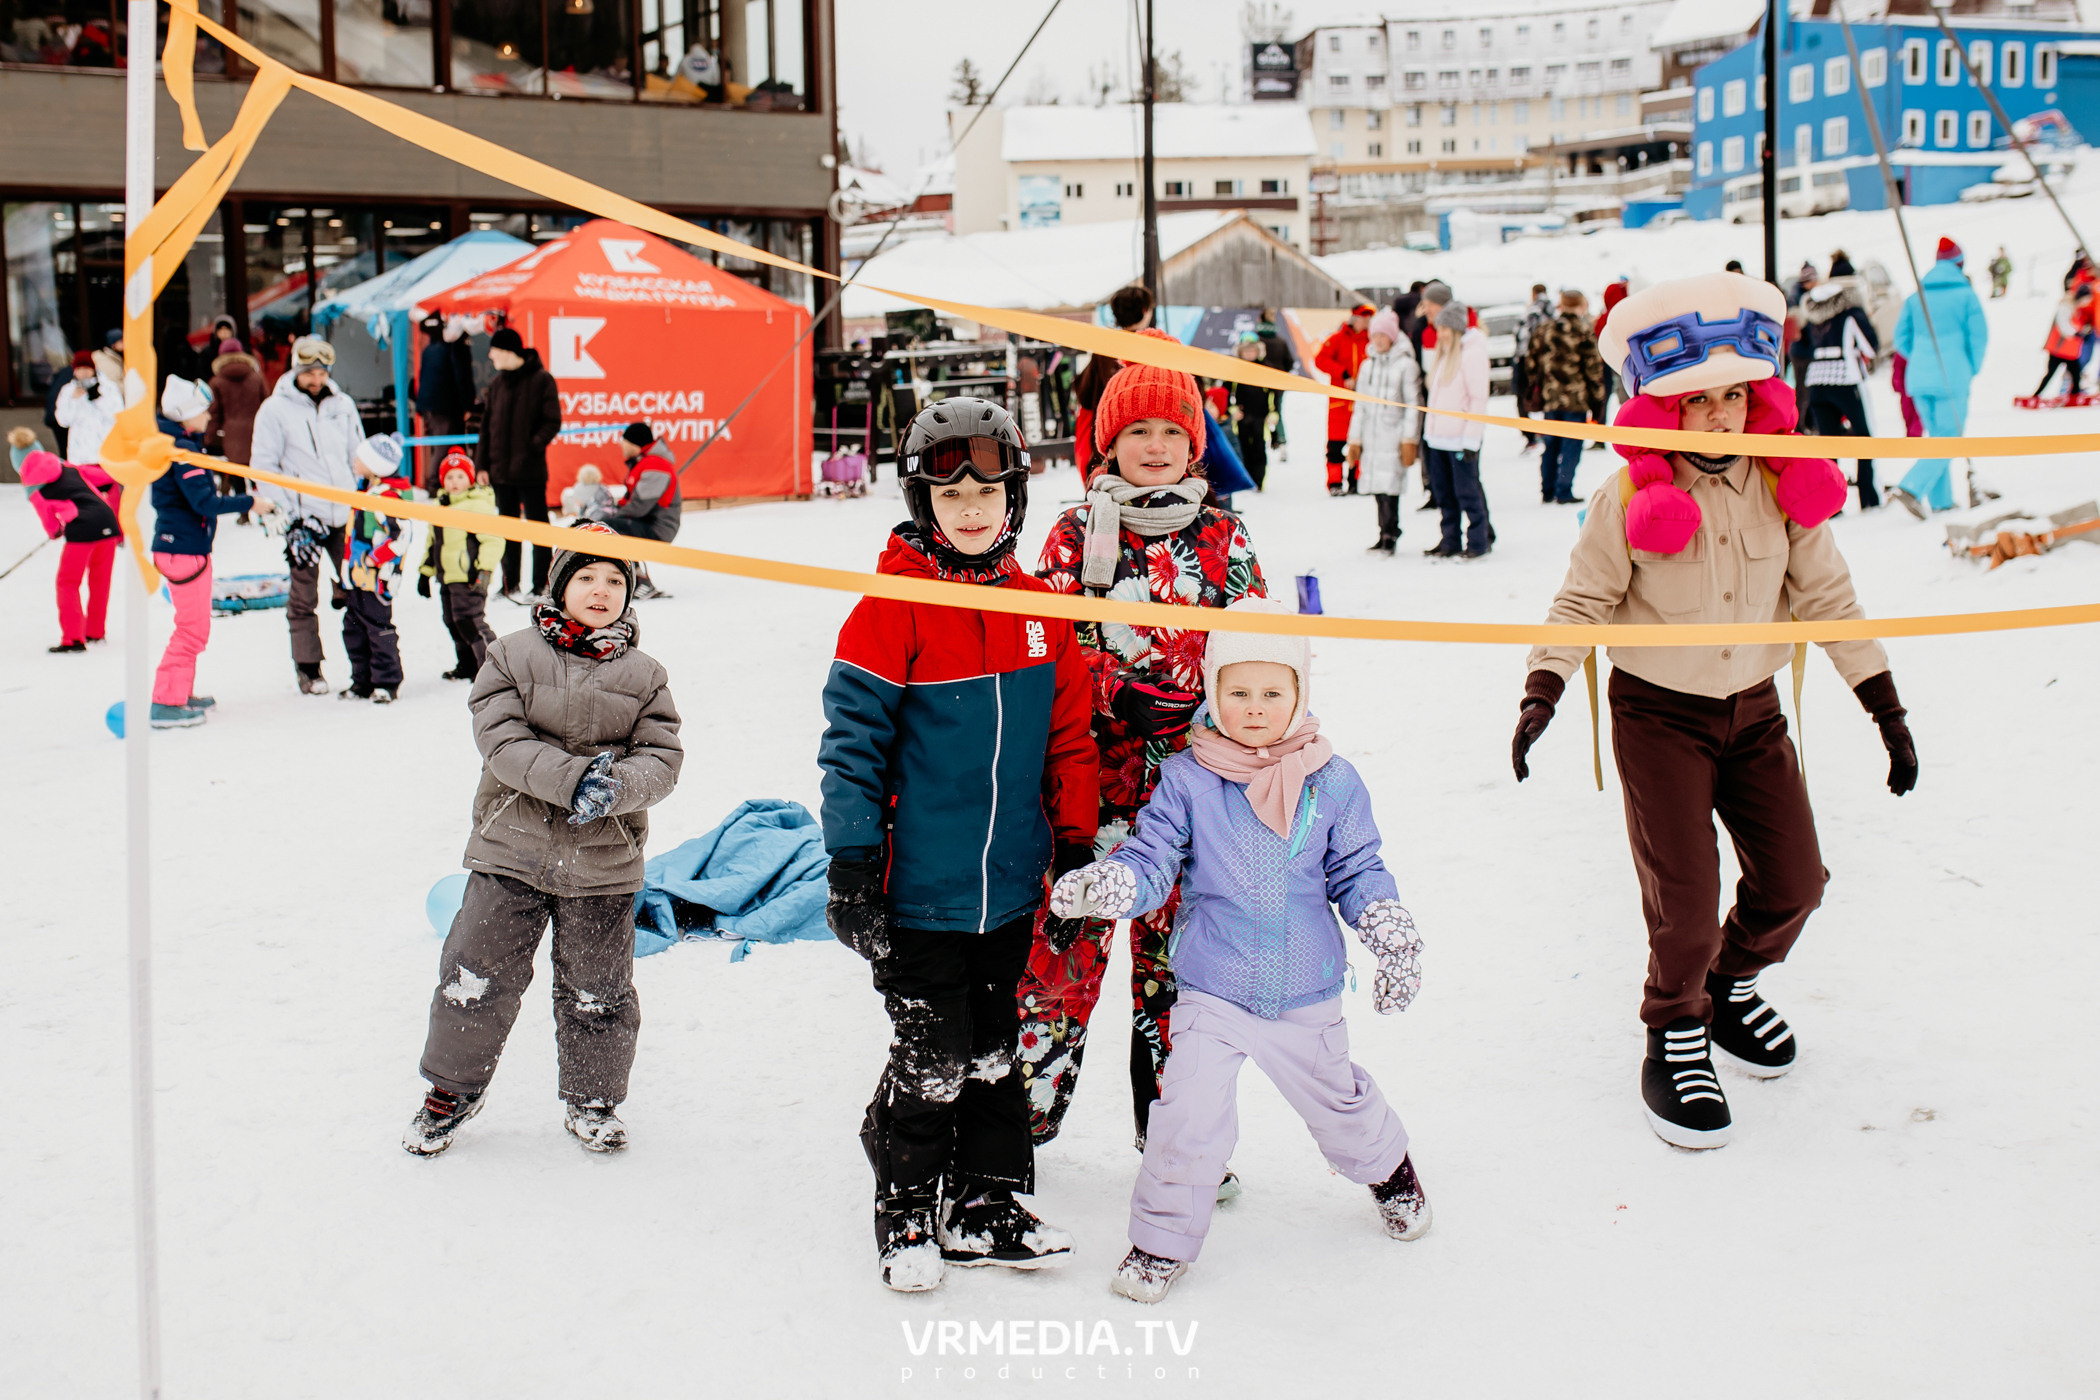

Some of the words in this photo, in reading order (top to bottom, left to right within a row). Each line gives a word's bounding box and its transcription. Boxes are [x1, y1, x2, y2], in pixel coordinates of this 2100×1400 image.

[558, 390, 704, 416] УЗБАССКАЯ
[552, 421, 630, 448] МЕДИ
[645, 417, 732, 442] РУППА
